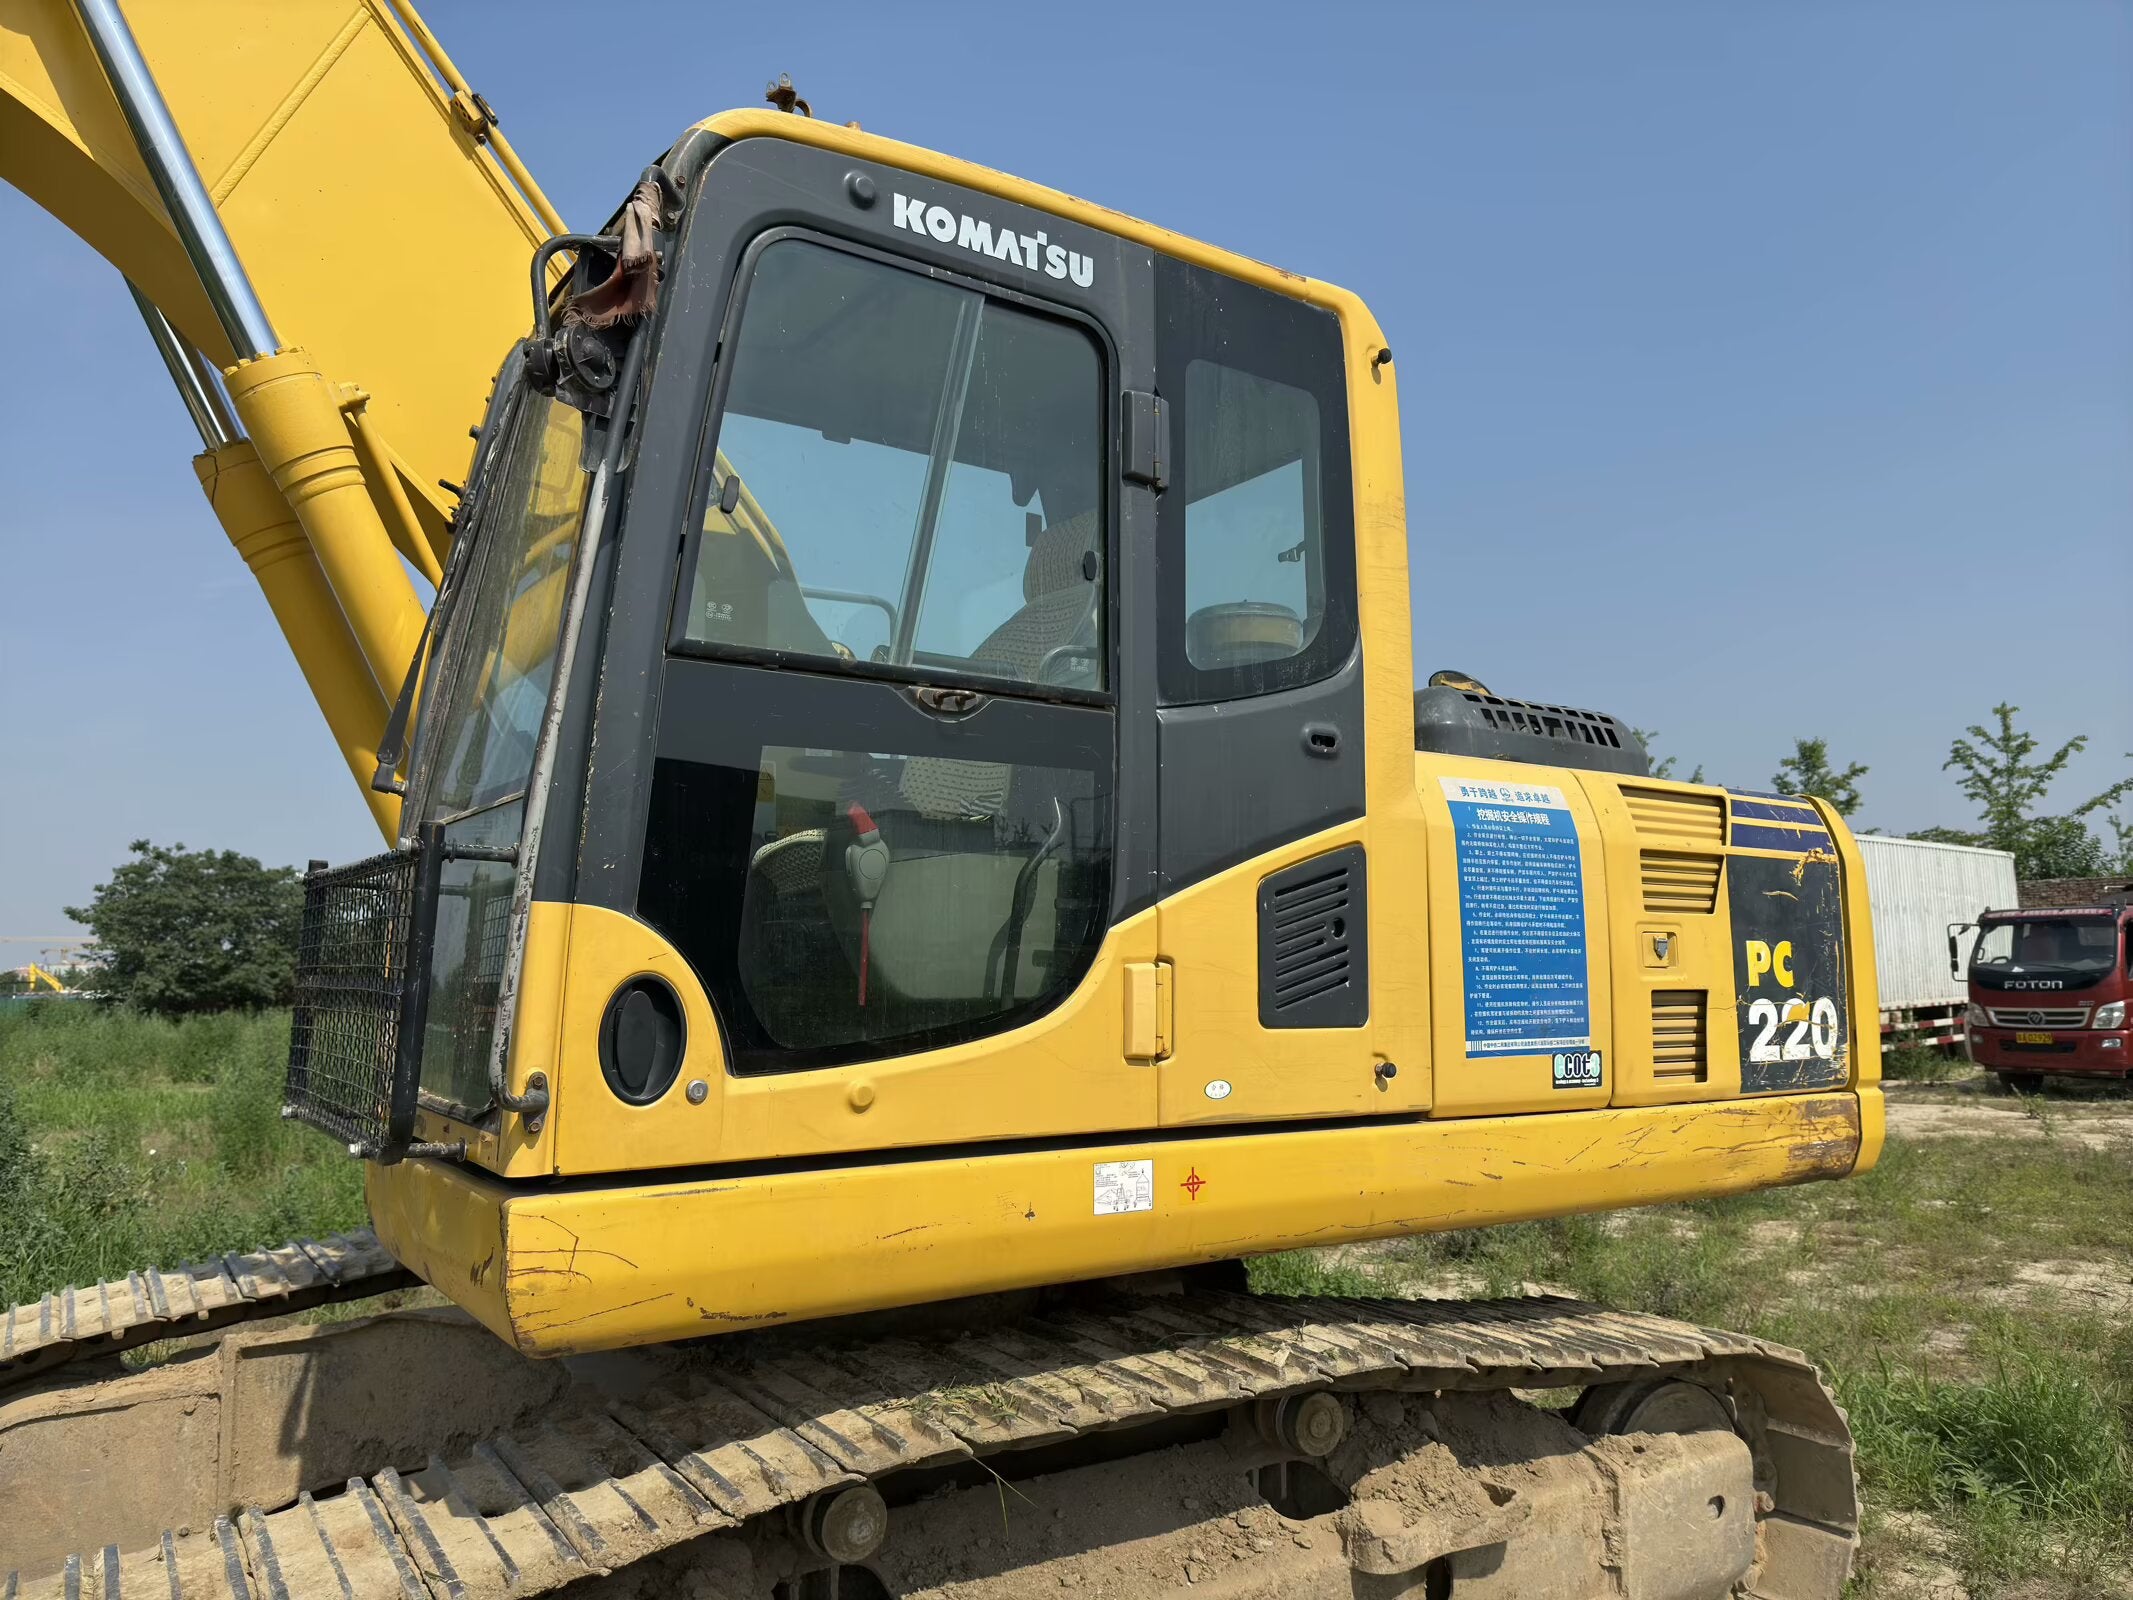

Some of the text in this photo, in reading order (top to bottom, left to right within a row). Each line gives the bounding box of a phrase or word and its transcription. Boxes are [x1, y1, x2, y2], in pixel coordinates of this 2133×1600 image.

[893, 192, 1094, 288] KOMATSU
[1745, 940, 1794, 988] PC
[2003, 980, 2063, 990] FOTON
[1748, 996, 1838, 1062] 220
